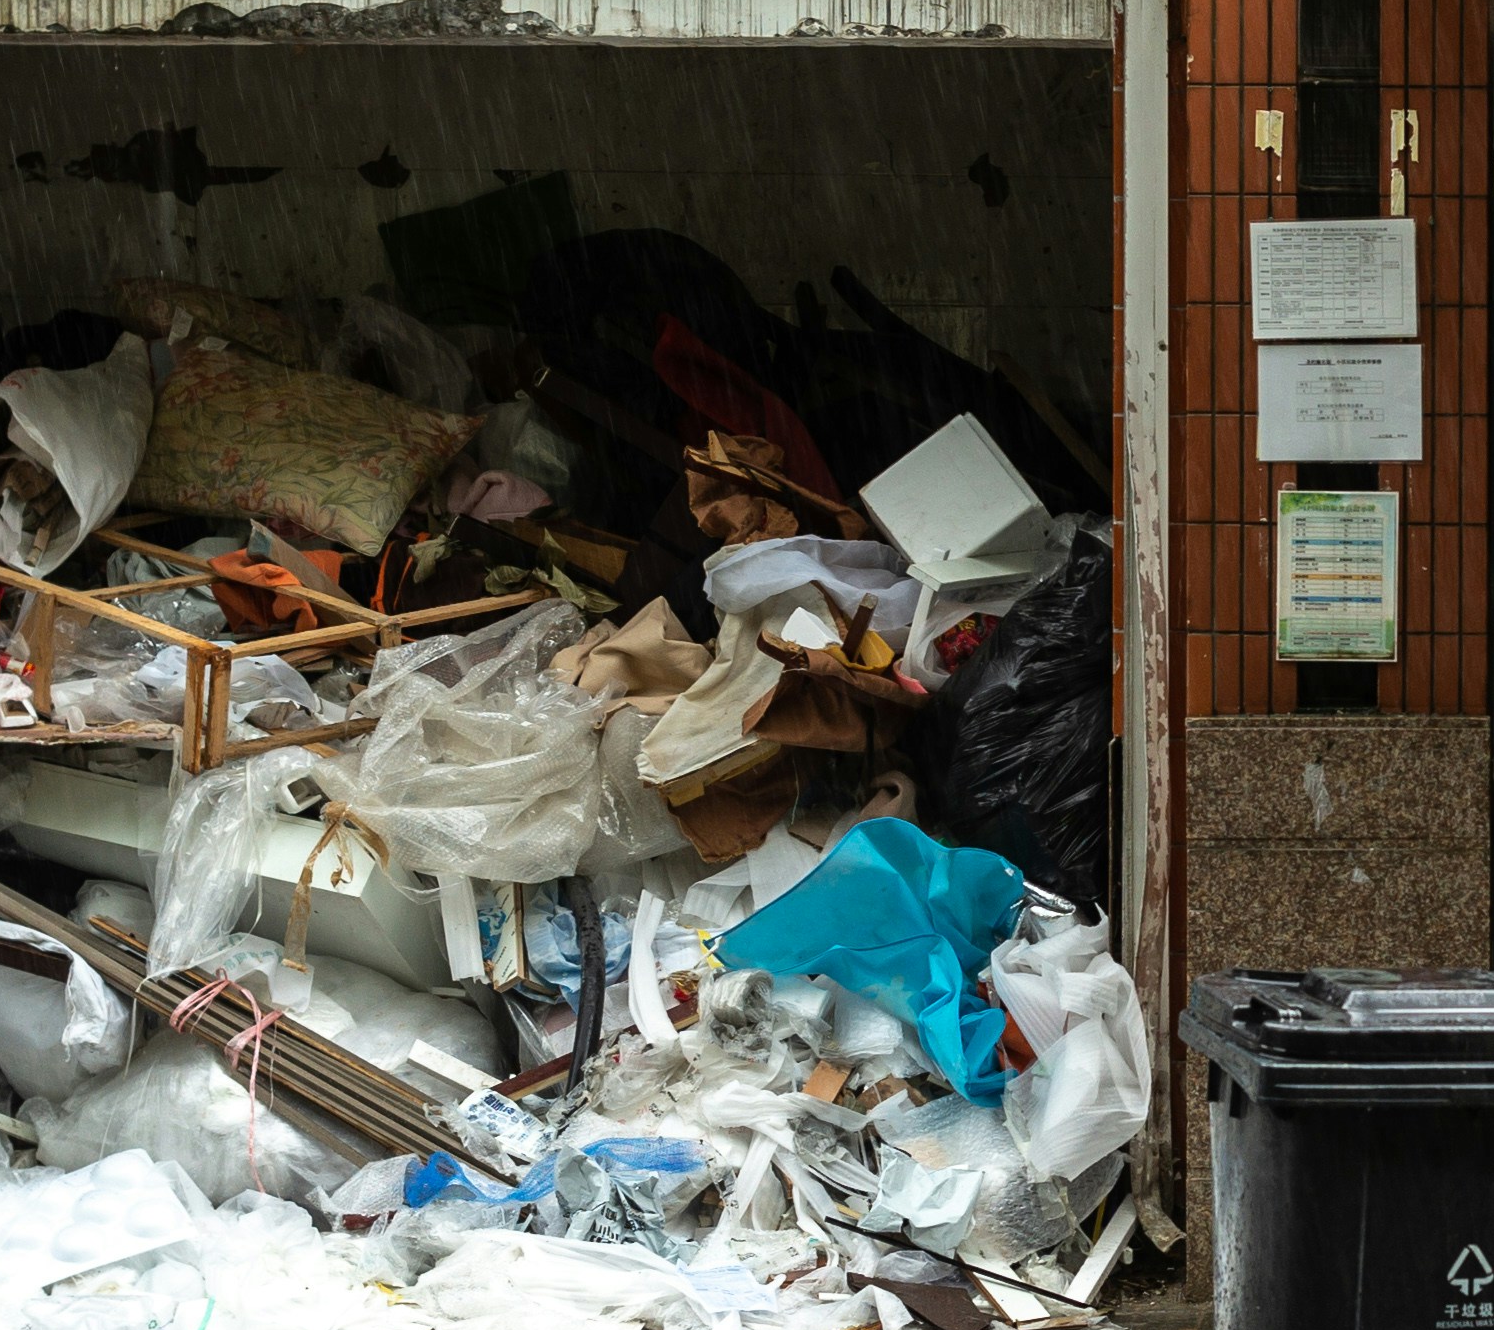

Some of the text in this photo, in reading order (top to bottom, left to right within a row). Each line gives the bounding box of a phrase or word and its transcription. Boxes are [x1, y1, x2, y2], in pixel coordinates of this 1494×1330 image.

[1443, 1302, 1494, 1320] 干垃圾
[1435, 1319, 1474, 1329] RESIDUAL
